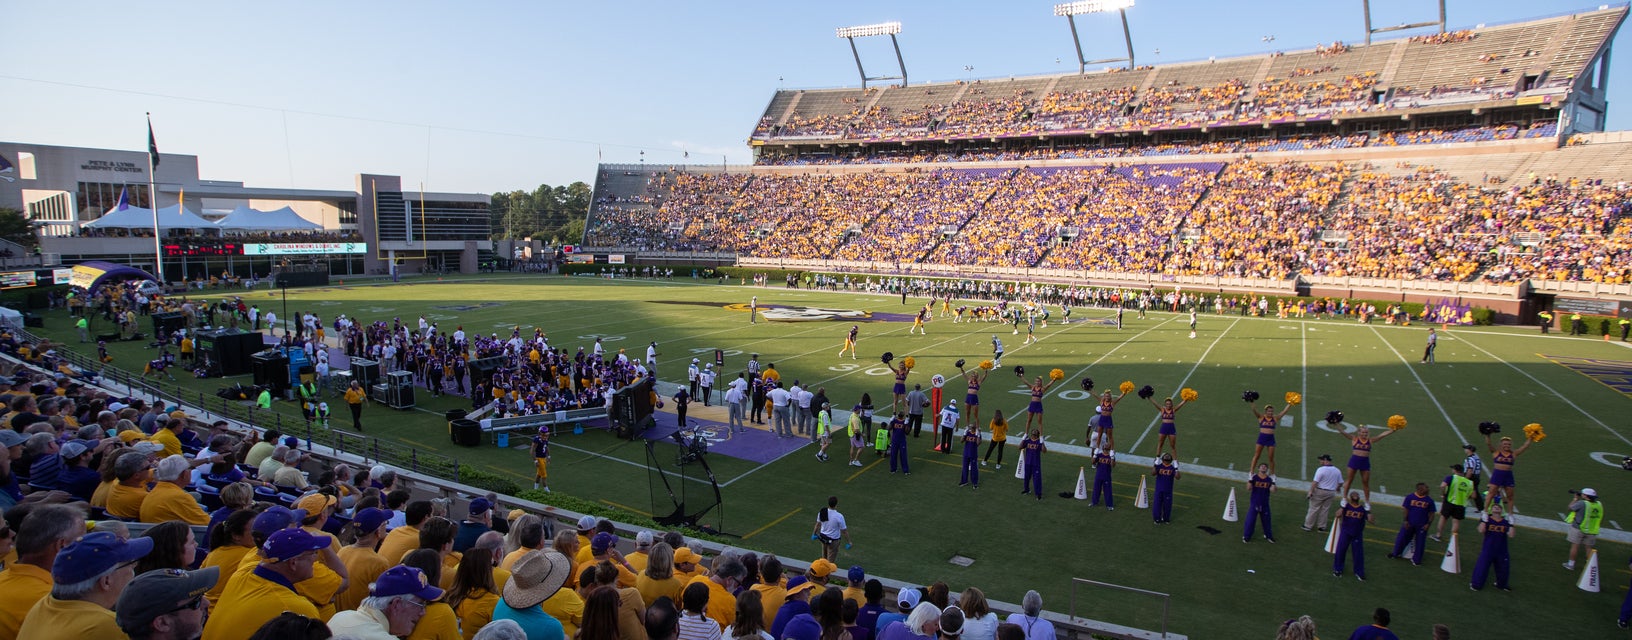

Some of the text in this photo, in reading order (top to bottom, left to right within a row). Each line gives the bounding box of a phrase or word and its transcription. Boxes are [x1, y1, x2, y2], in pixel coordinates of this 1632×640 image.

[114, 165, 143, 173] CENTER
[828, 363, 895, 376] 30
[1409, 499, 1429, 508] ECU
[1345, 510, 1364, 518] ECU
[1488, 523, 1506, 533] ECU
